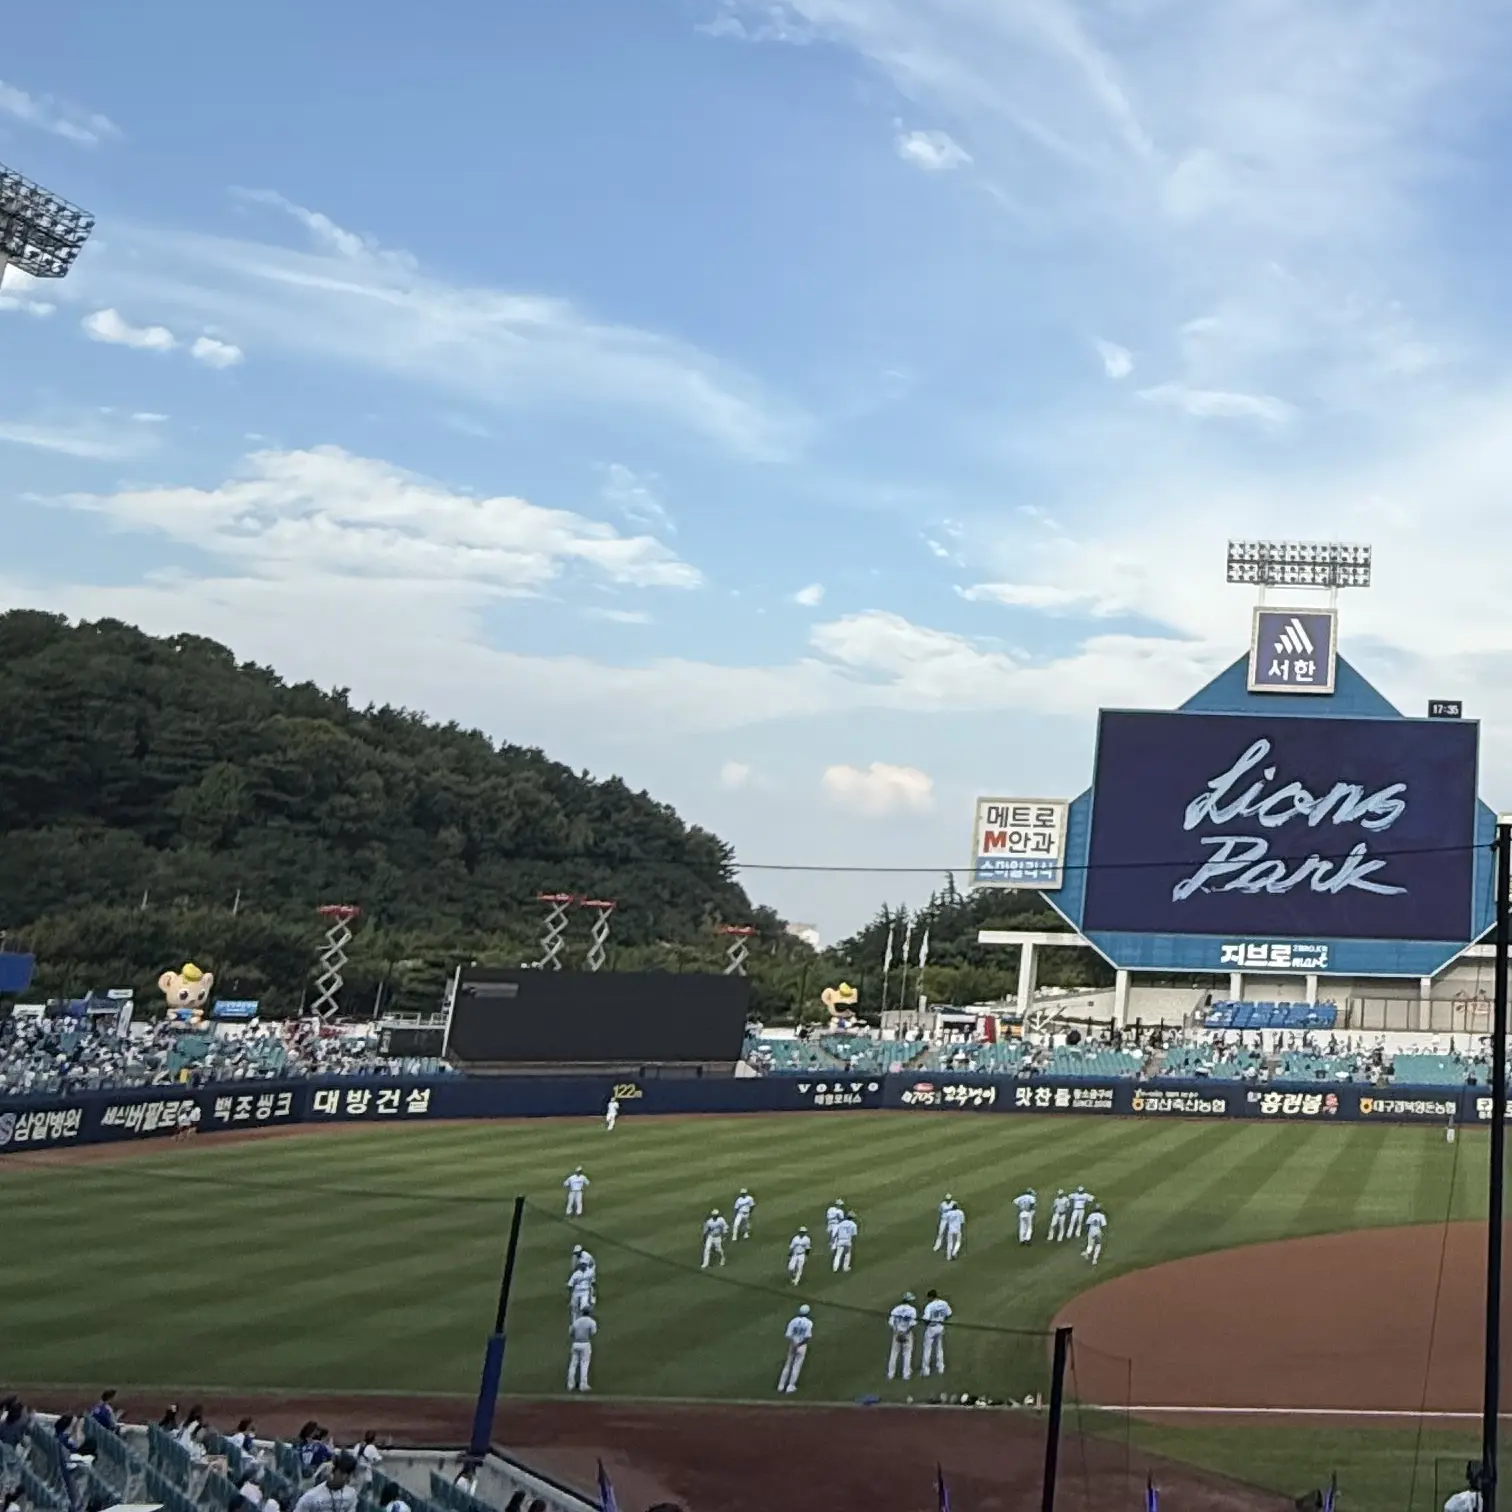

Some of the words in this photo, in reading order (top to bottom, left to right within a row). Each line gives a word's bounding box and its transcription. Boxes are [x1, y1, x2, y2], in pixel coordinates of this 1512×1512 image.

[1268, 659, 1316, 682] 서한
[1183, 738, 1407, 832] Lions
[986, 806, 1056, 828] 메트로
[983, 830, 1055, 854] M안과
[1172, 836, 1408, 902] Park
[1220, 943, 1291, 968] 지브로
[797, 1082, 879, 1093] VOLVO
[214, 1092, 292, 1122] 백조씽크
[313, 1088, 431, 1114] 대방건설
[14, 1108, 83, 1141] 삼일병원
